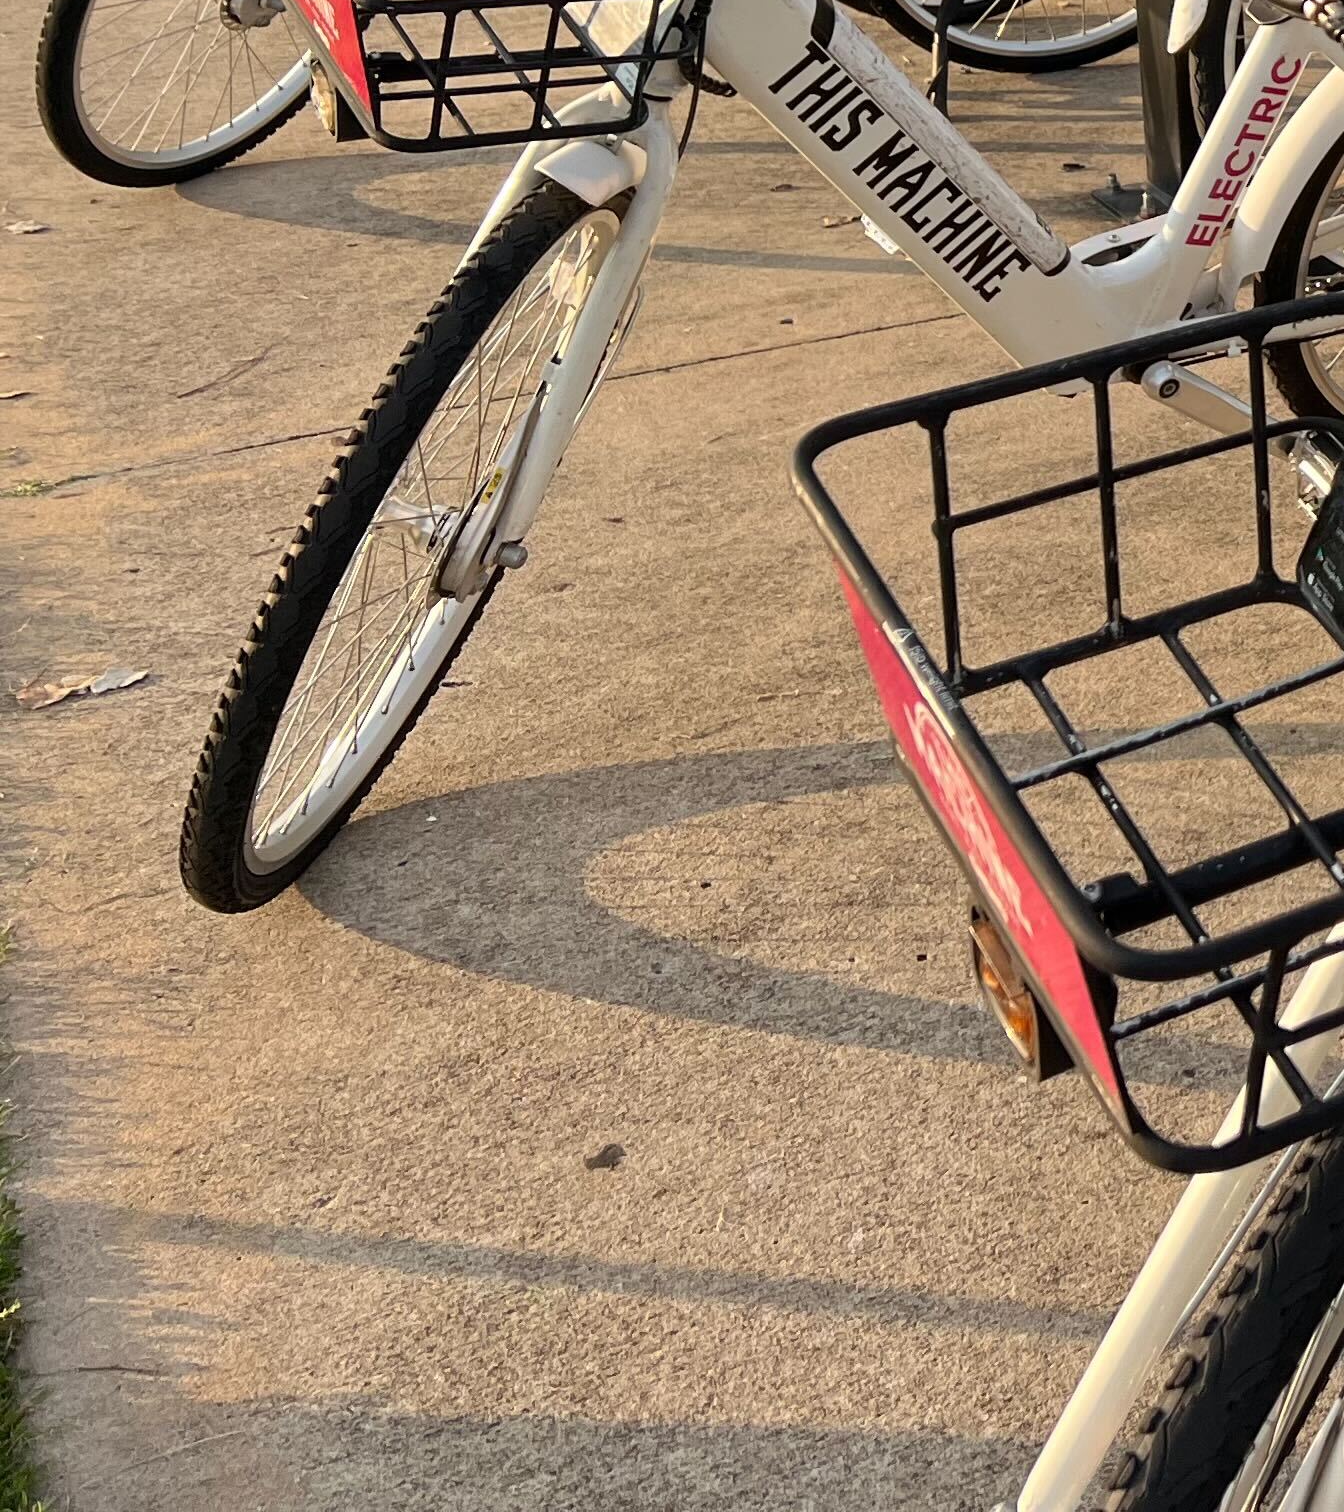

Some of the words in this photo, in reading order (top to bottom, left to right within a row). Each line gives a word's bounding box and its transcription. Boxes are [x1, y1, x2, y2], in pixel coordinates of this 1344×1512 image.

[768, 40, 885, 152] THIS
[853, 129, 1033, 303] MACHINE
[1185, 56, 1302, 247] ELECTRIC
